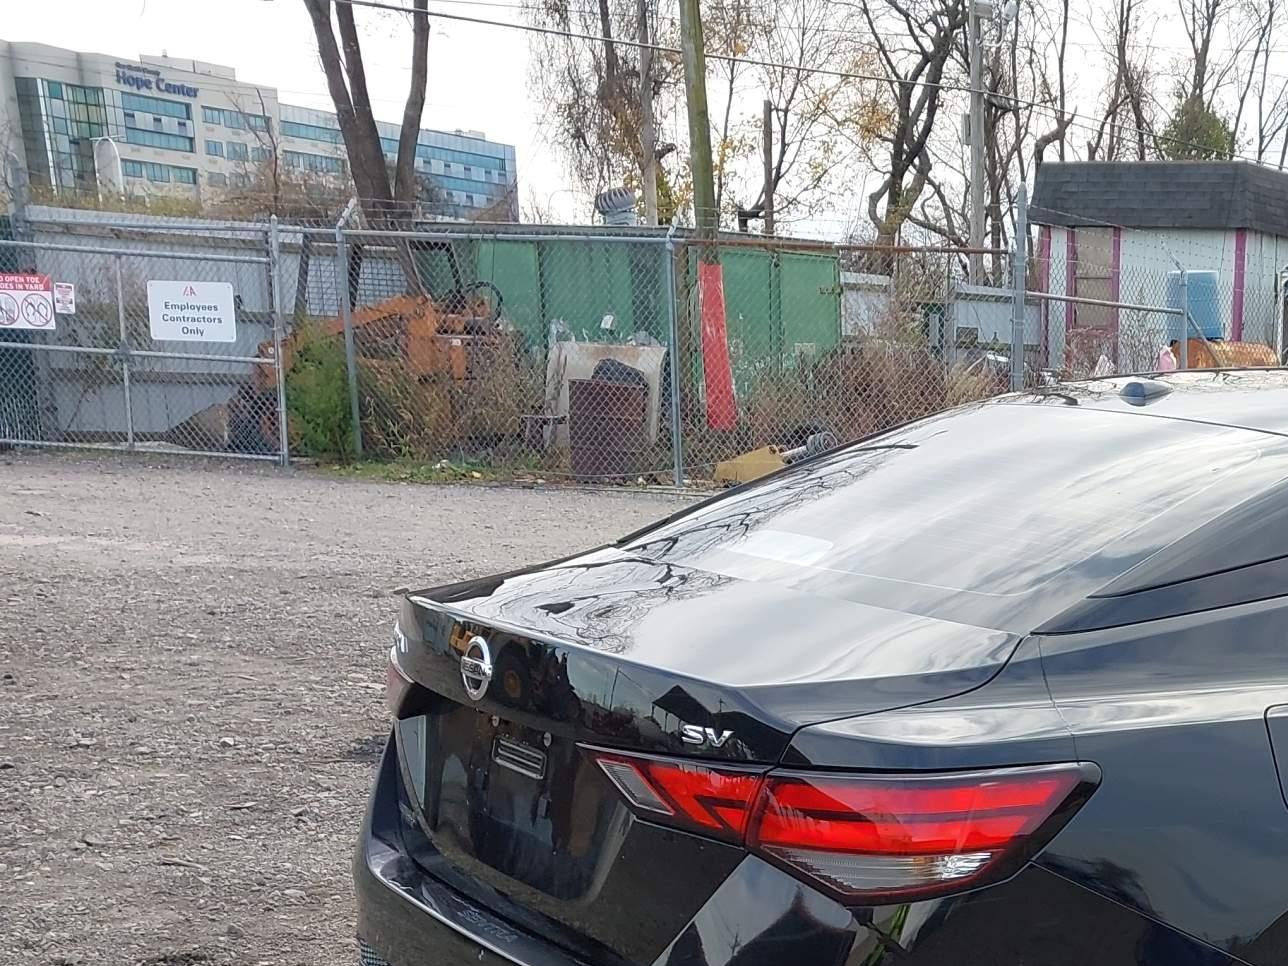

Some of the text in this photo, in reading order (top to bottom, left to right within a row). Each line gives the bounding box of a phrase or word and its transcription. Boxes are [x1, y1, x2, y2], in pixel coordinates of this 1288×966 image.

[116, 69, 152, 90] Hope
[156, 78, 199, 98] Center
[4, 275, 25, 283] OPEN
[164, 301, 218, 312] Employees
[162, 313, 223, 324] Contractors
[181, 326, 204, 337] Only
[681, 724, 734, 747] SV
